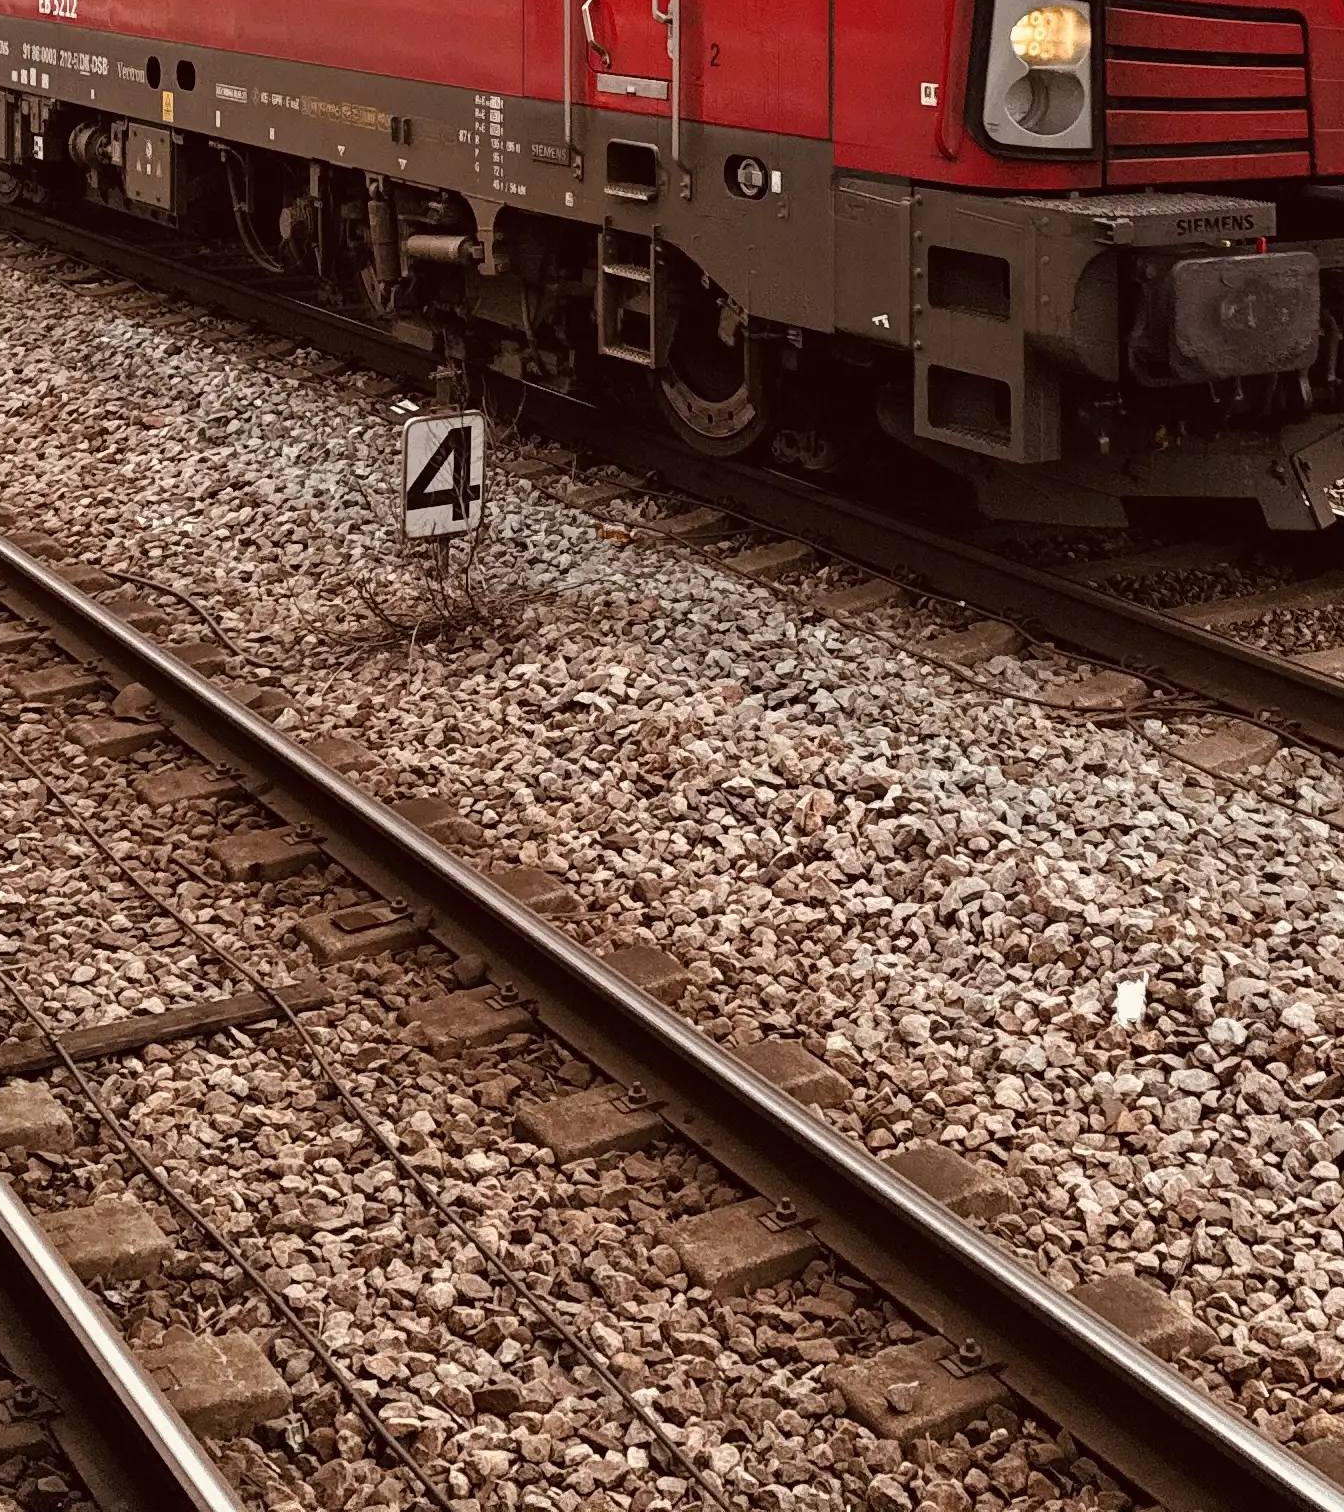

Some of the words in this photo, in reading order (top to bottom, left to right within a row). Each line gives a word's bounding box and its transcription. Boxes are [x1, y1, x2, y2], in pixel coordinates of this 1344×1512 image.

[710, 42, 720, 67] 2
[531, 144, 568, 161] SIEMENS
[1176, 214, 1255, 237] SIEMENS
[407, 426, 481, 521] 4
